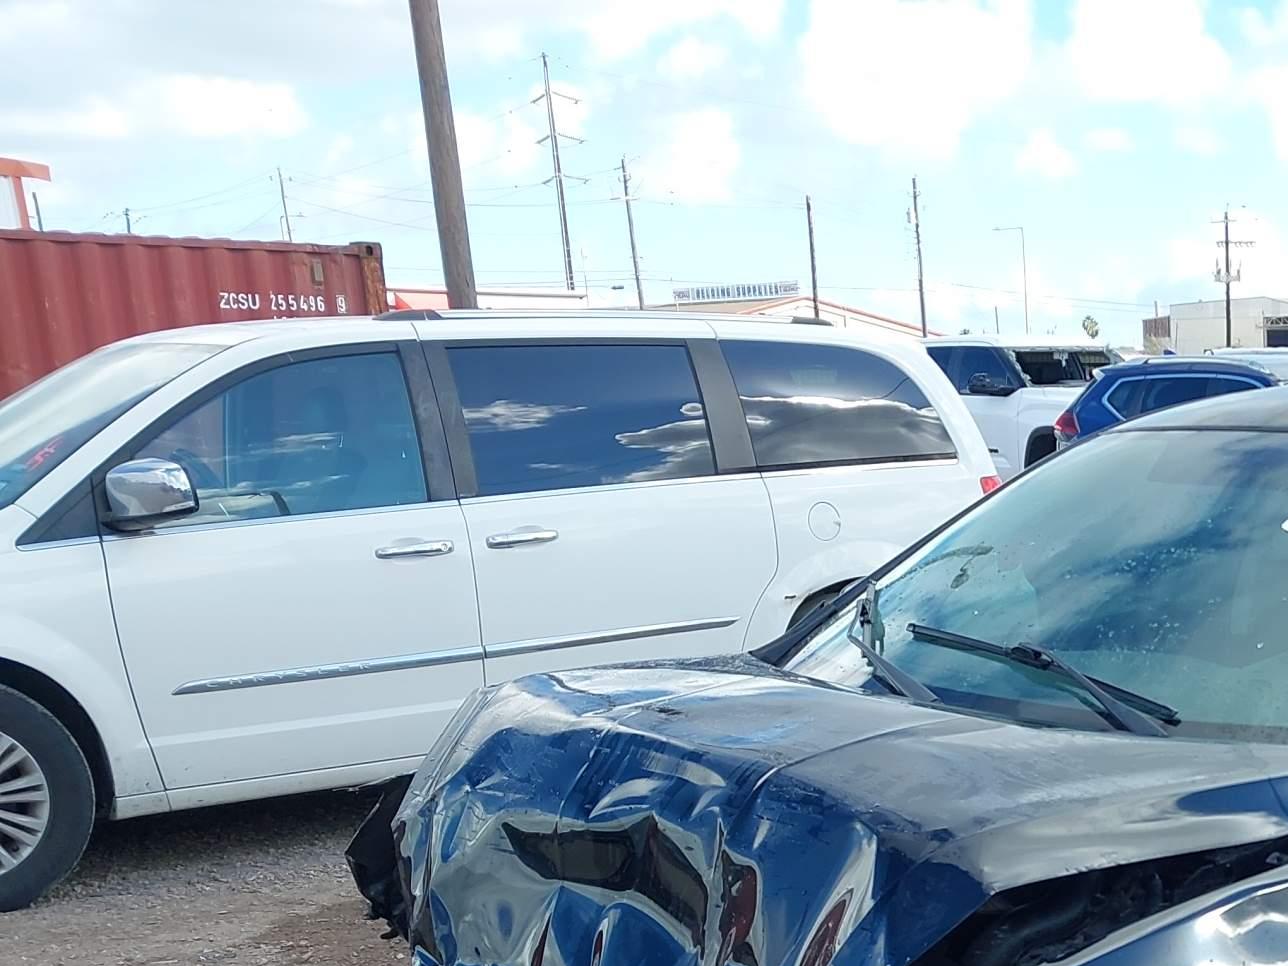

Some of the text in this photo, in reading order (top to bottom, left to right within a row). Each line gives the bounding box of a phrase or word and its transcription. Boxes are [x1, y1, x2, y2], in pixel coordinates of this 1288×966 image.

[219, 292, 346, 312] ZCSU 255496 9
[206, 663, 370, 688] CHRYSLER
